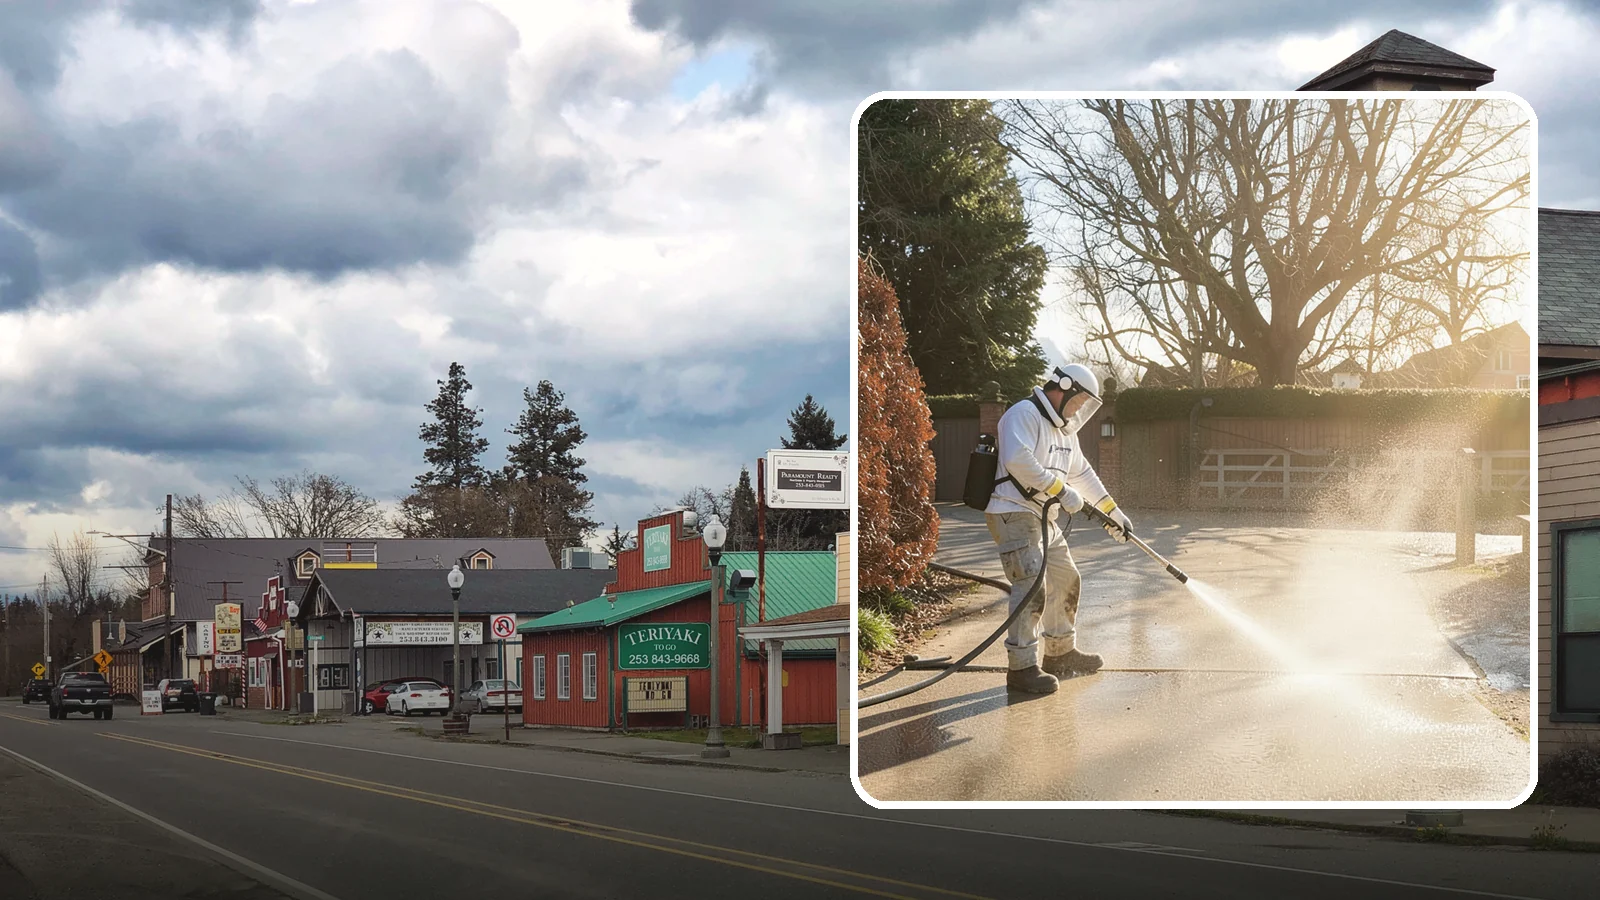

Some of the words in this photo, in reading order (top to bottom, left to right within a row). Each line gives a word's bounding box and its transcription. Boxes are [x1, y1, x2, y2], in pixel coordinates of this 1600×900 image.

[781, 471, 814, 479] PARAMOUNT
[817, 472, 839, 480] REALTY
[625, 627, 702, 646] TERIYAKI
[629, 654, 648, 664] 253
[651, 654, 700, 664] 843-9668
